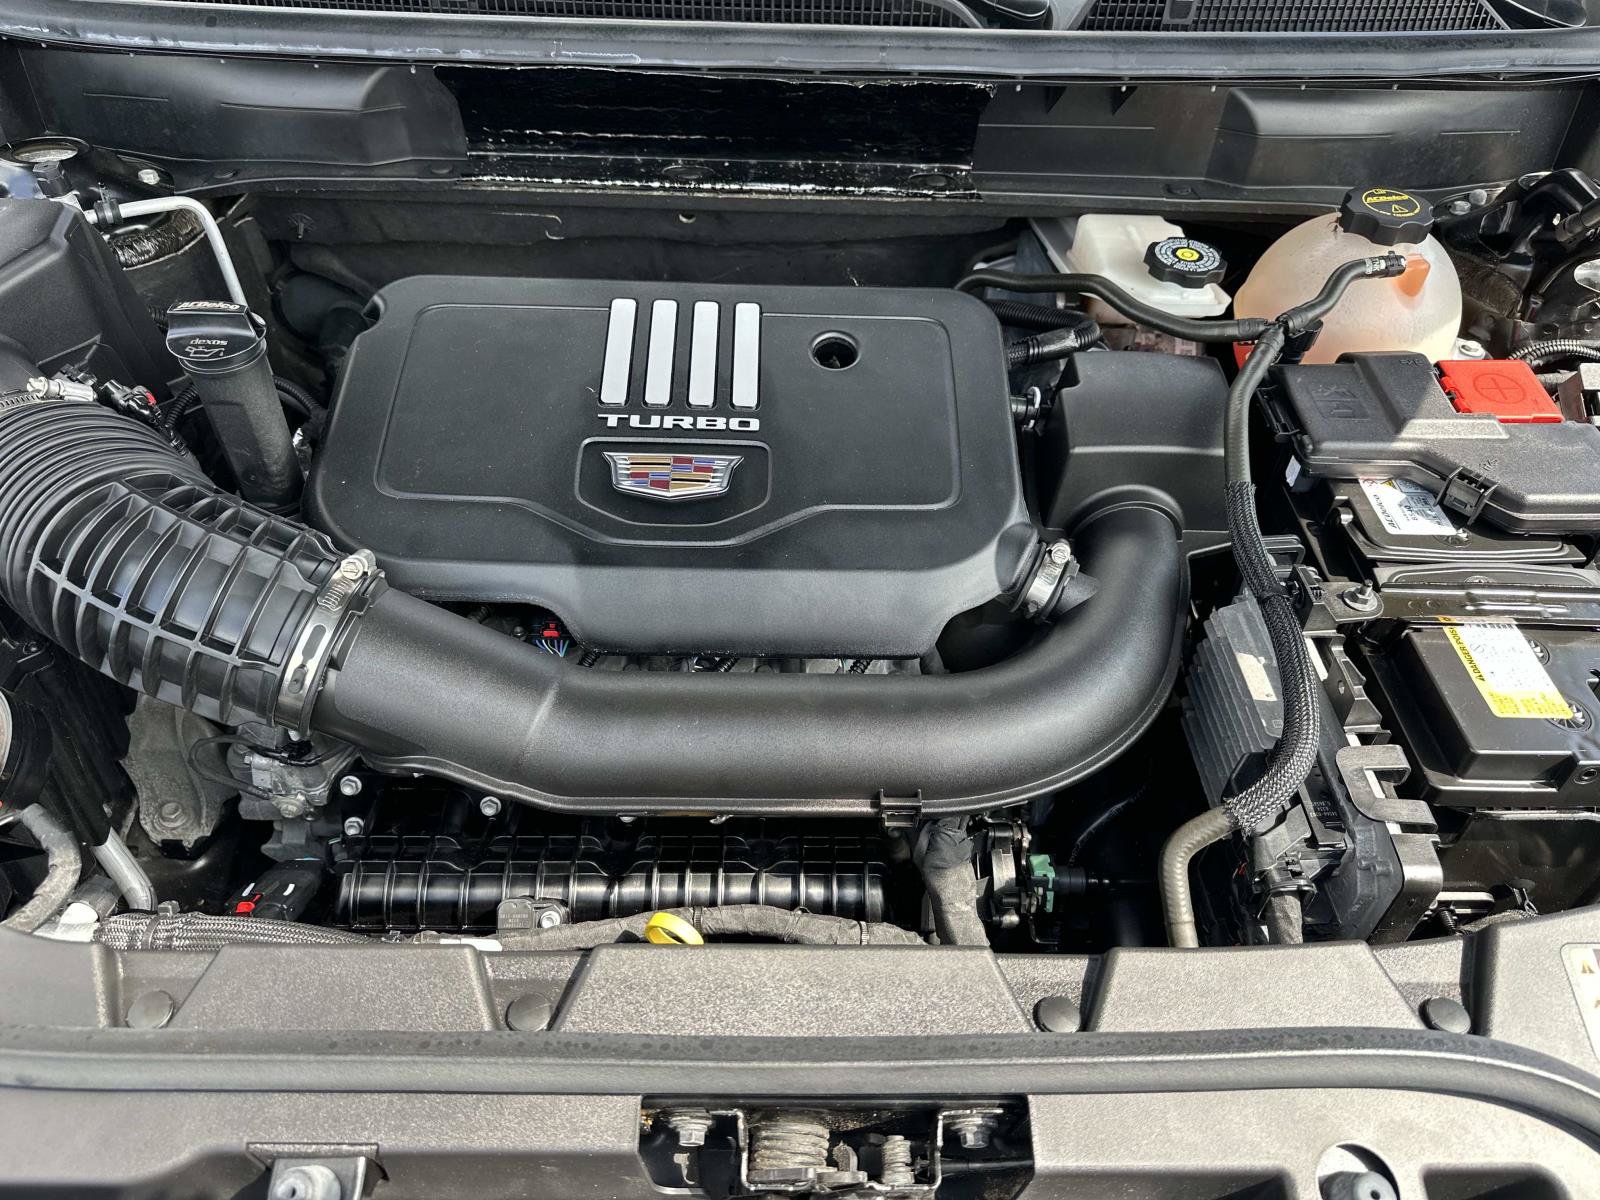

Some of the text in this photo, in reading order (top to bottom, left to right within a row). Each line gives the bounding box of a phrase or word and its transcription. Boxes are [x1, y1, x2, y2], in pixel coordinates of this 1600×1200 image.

[176, 301, 240, 310] ACDelco
[597, 413, 760, 431] TURBO
[1448, 627, 1481, 674] DANGER POIS
